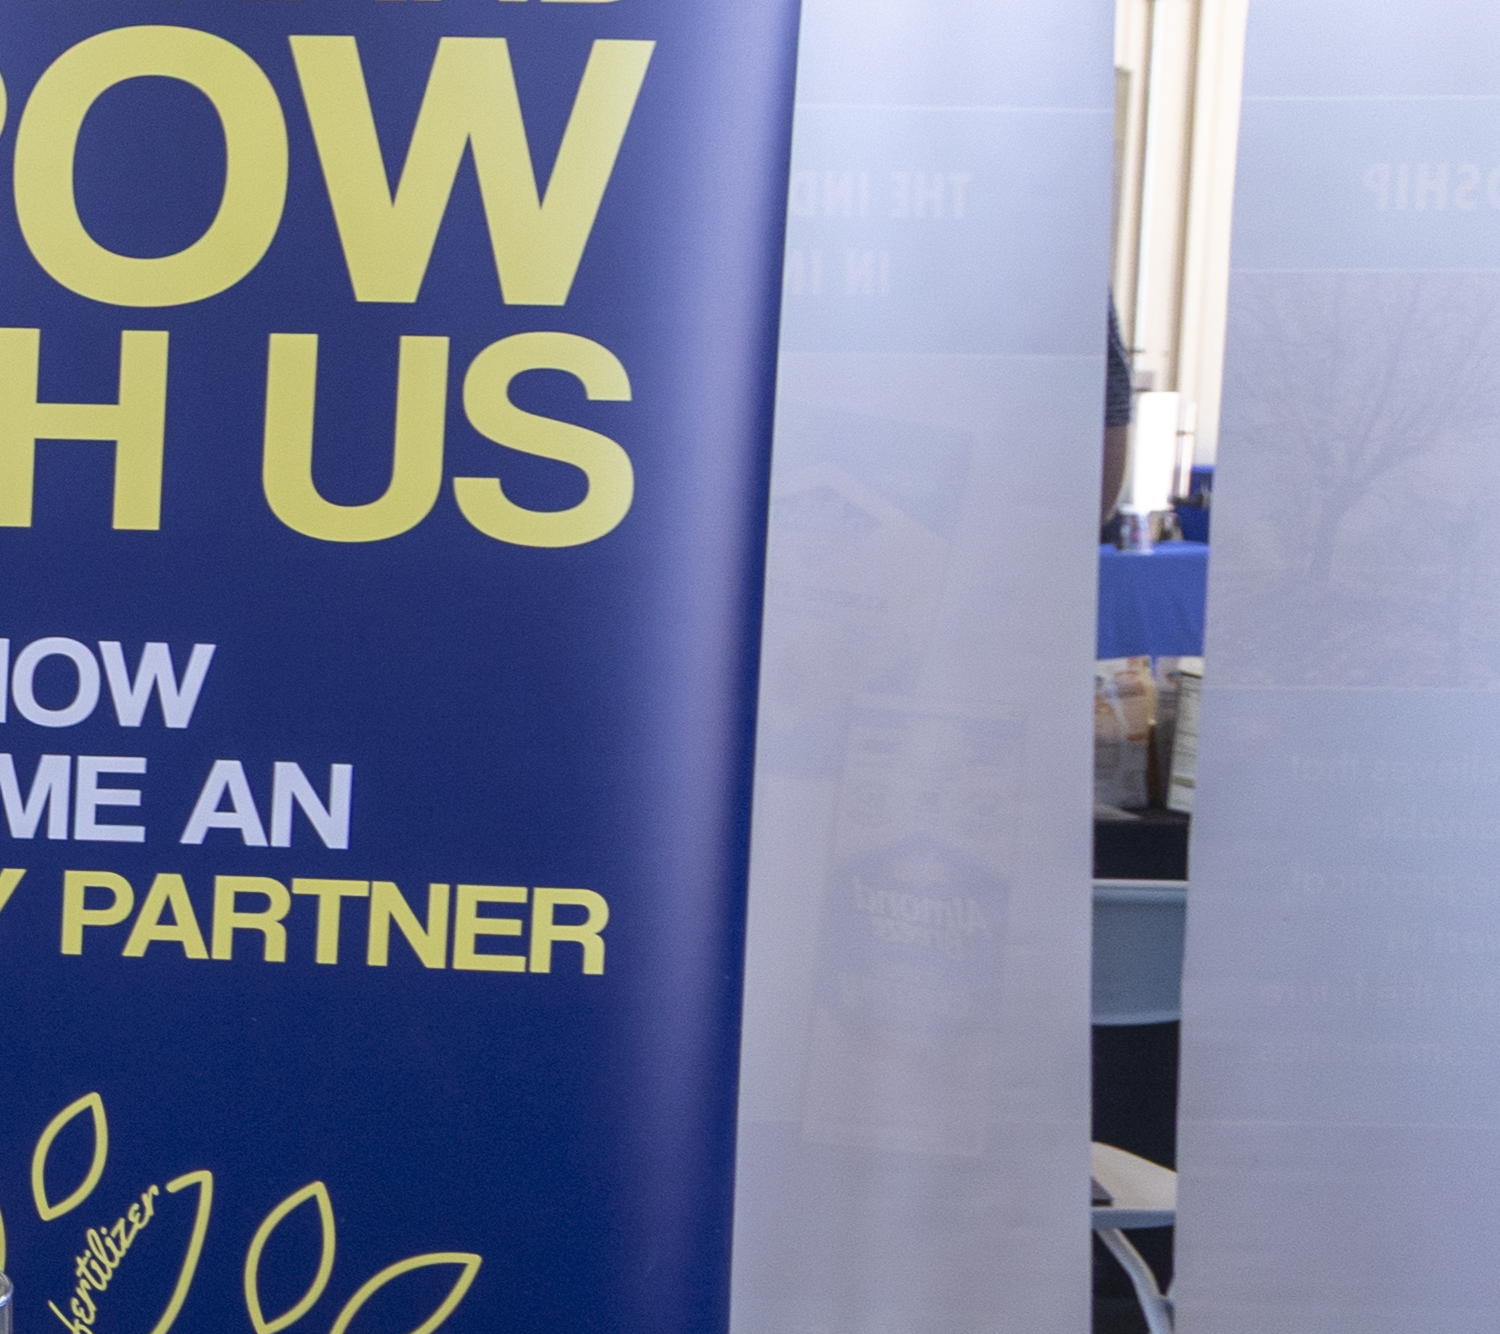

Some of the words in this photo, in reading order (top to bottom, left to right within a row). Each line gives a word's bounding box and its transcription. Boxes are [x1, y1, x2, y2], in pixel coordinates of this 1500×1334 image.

[260, 331, 636, 548] US
[180, 760, 354, 851] AN
[59, 869, 611, 976] PARTNER
